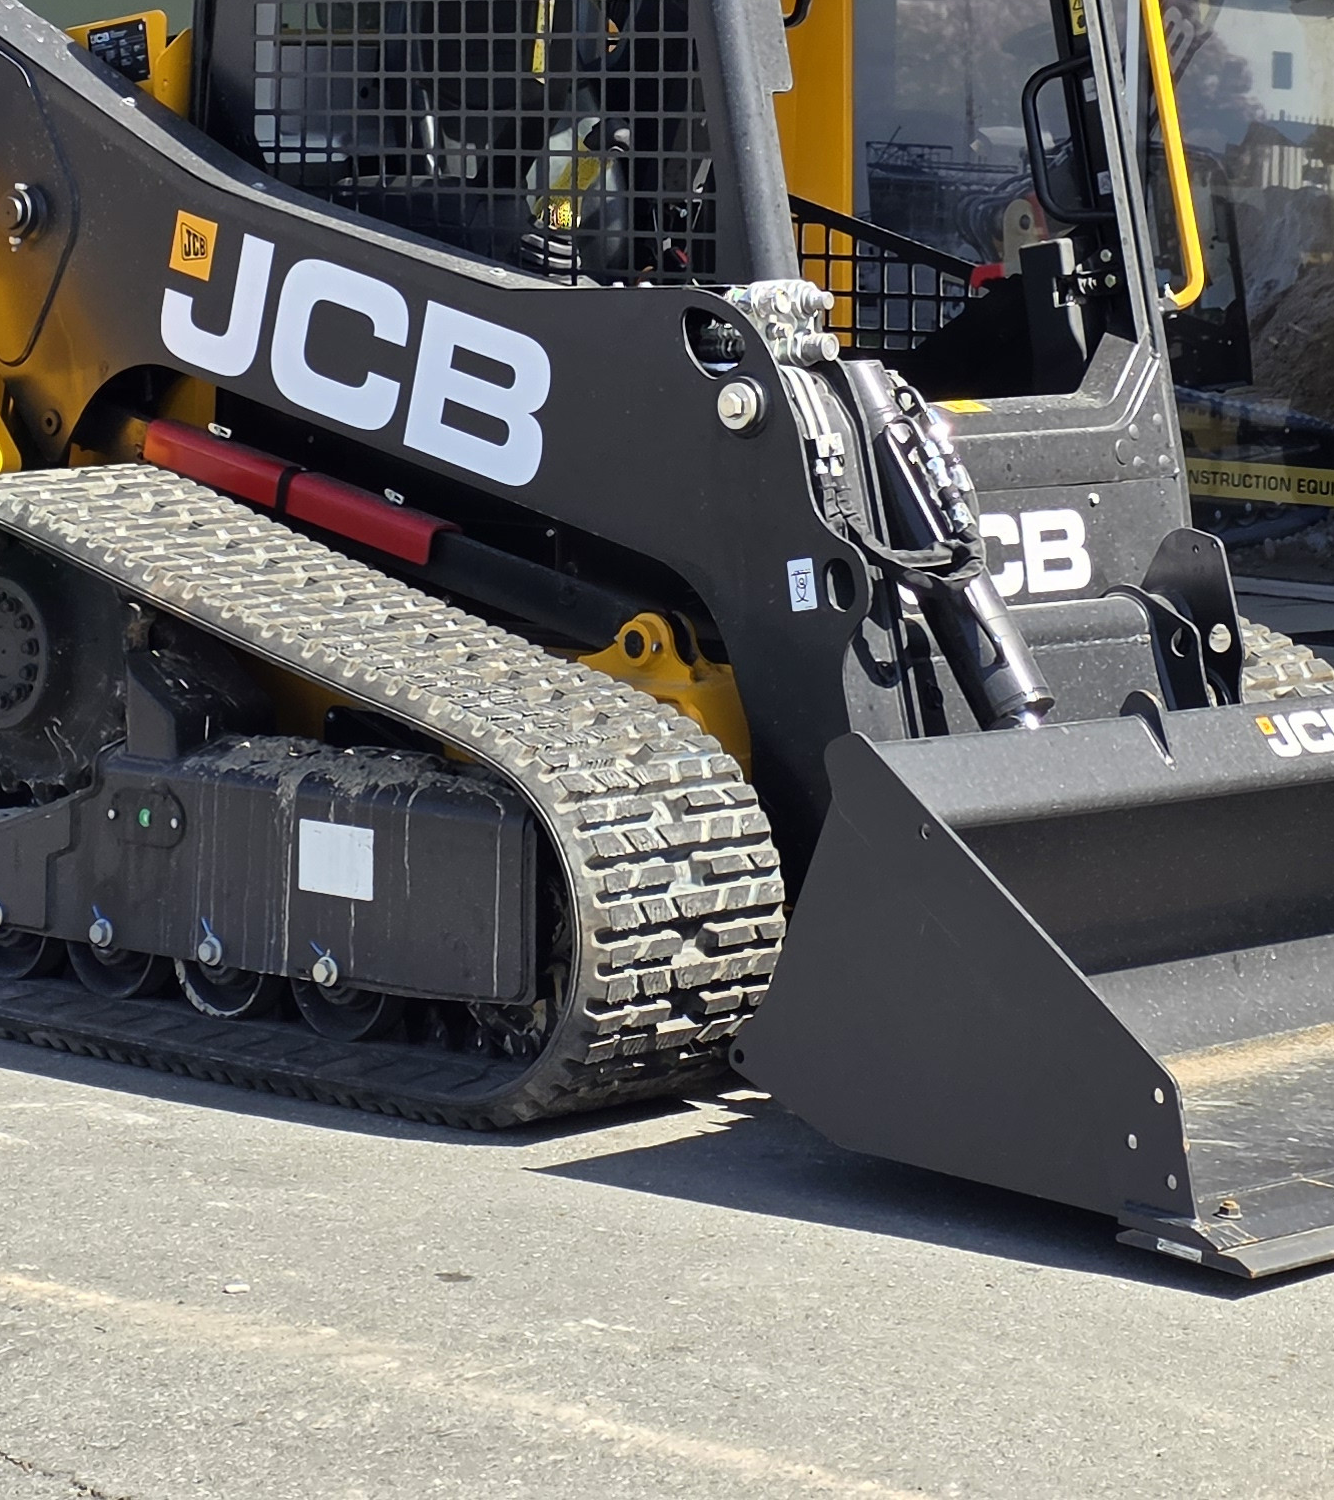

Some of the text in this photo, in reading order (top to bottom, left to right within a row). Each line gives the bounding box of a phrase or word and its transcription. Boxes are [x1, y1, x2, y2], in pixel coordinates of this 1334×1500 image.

[184, 228, 206, 257] JCB
[161, 233, 551, 486] JCB
[1188, 469, 1292, 492] NSTRUCTION
[979, 509, 1092, 598] CB
